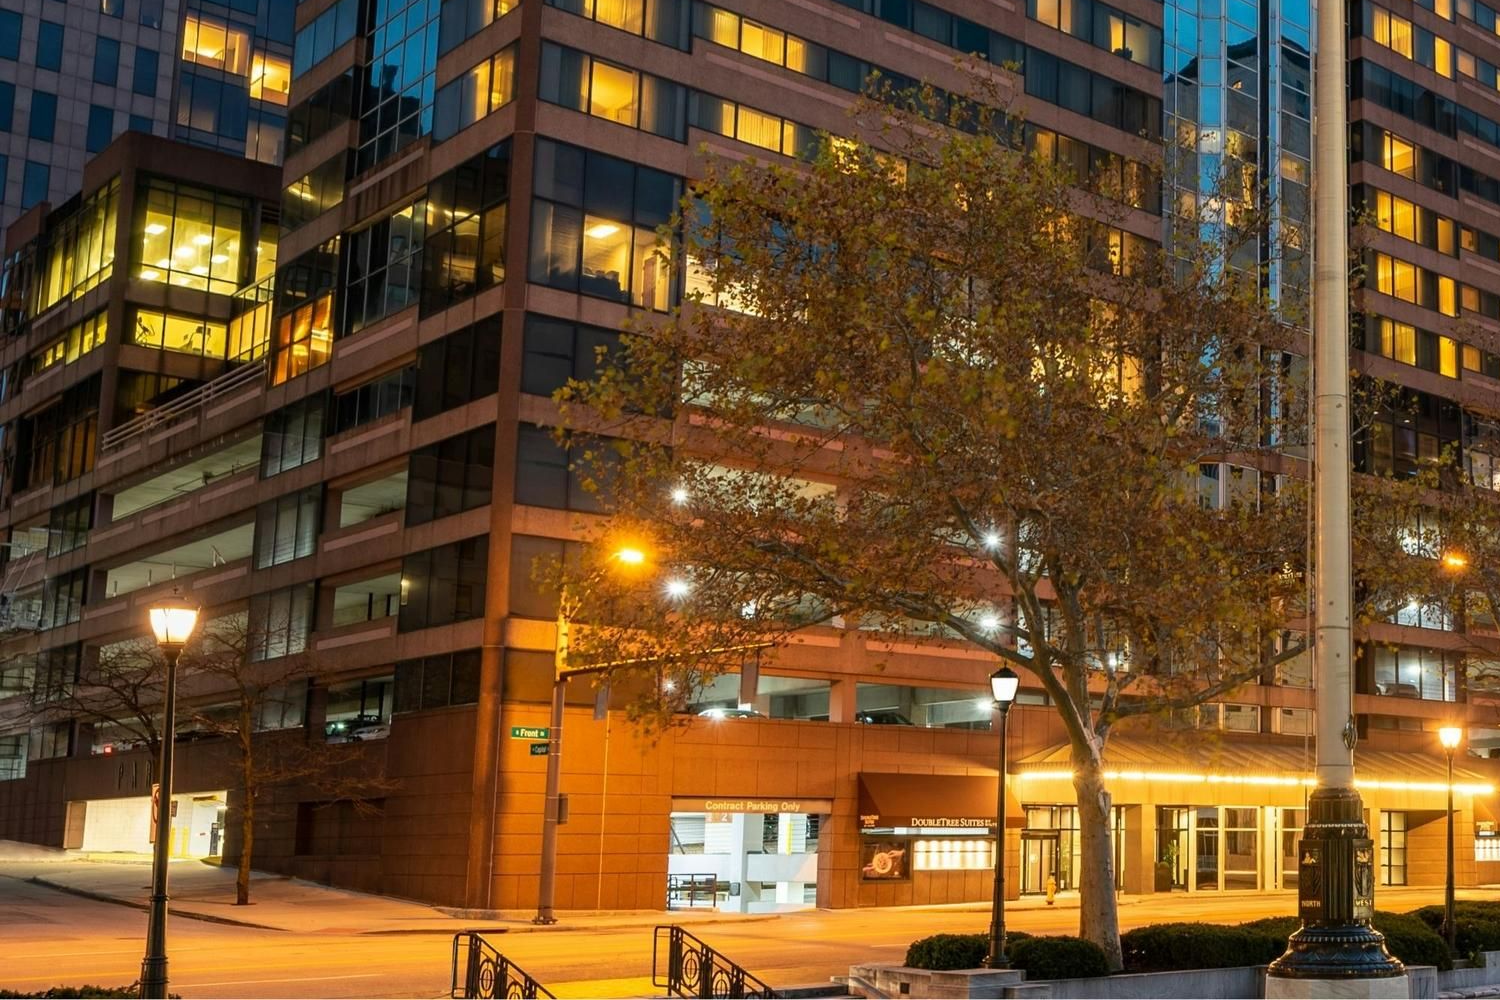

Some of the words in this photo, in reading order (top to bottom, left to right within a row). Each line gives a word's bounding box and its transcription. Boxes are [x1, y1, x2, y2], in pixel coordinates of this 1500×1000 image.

[520, 728, 539, 738] Front
[705, 800, 744, 811] Contract
[746, 801, 779, 812] Parking
[781, 801, 801, 813] Only
[960, 817, 985, 827] SUITES
[1301, 900, 1321, 908] NORTH
[1355, 899, 1372, 907] WEST
